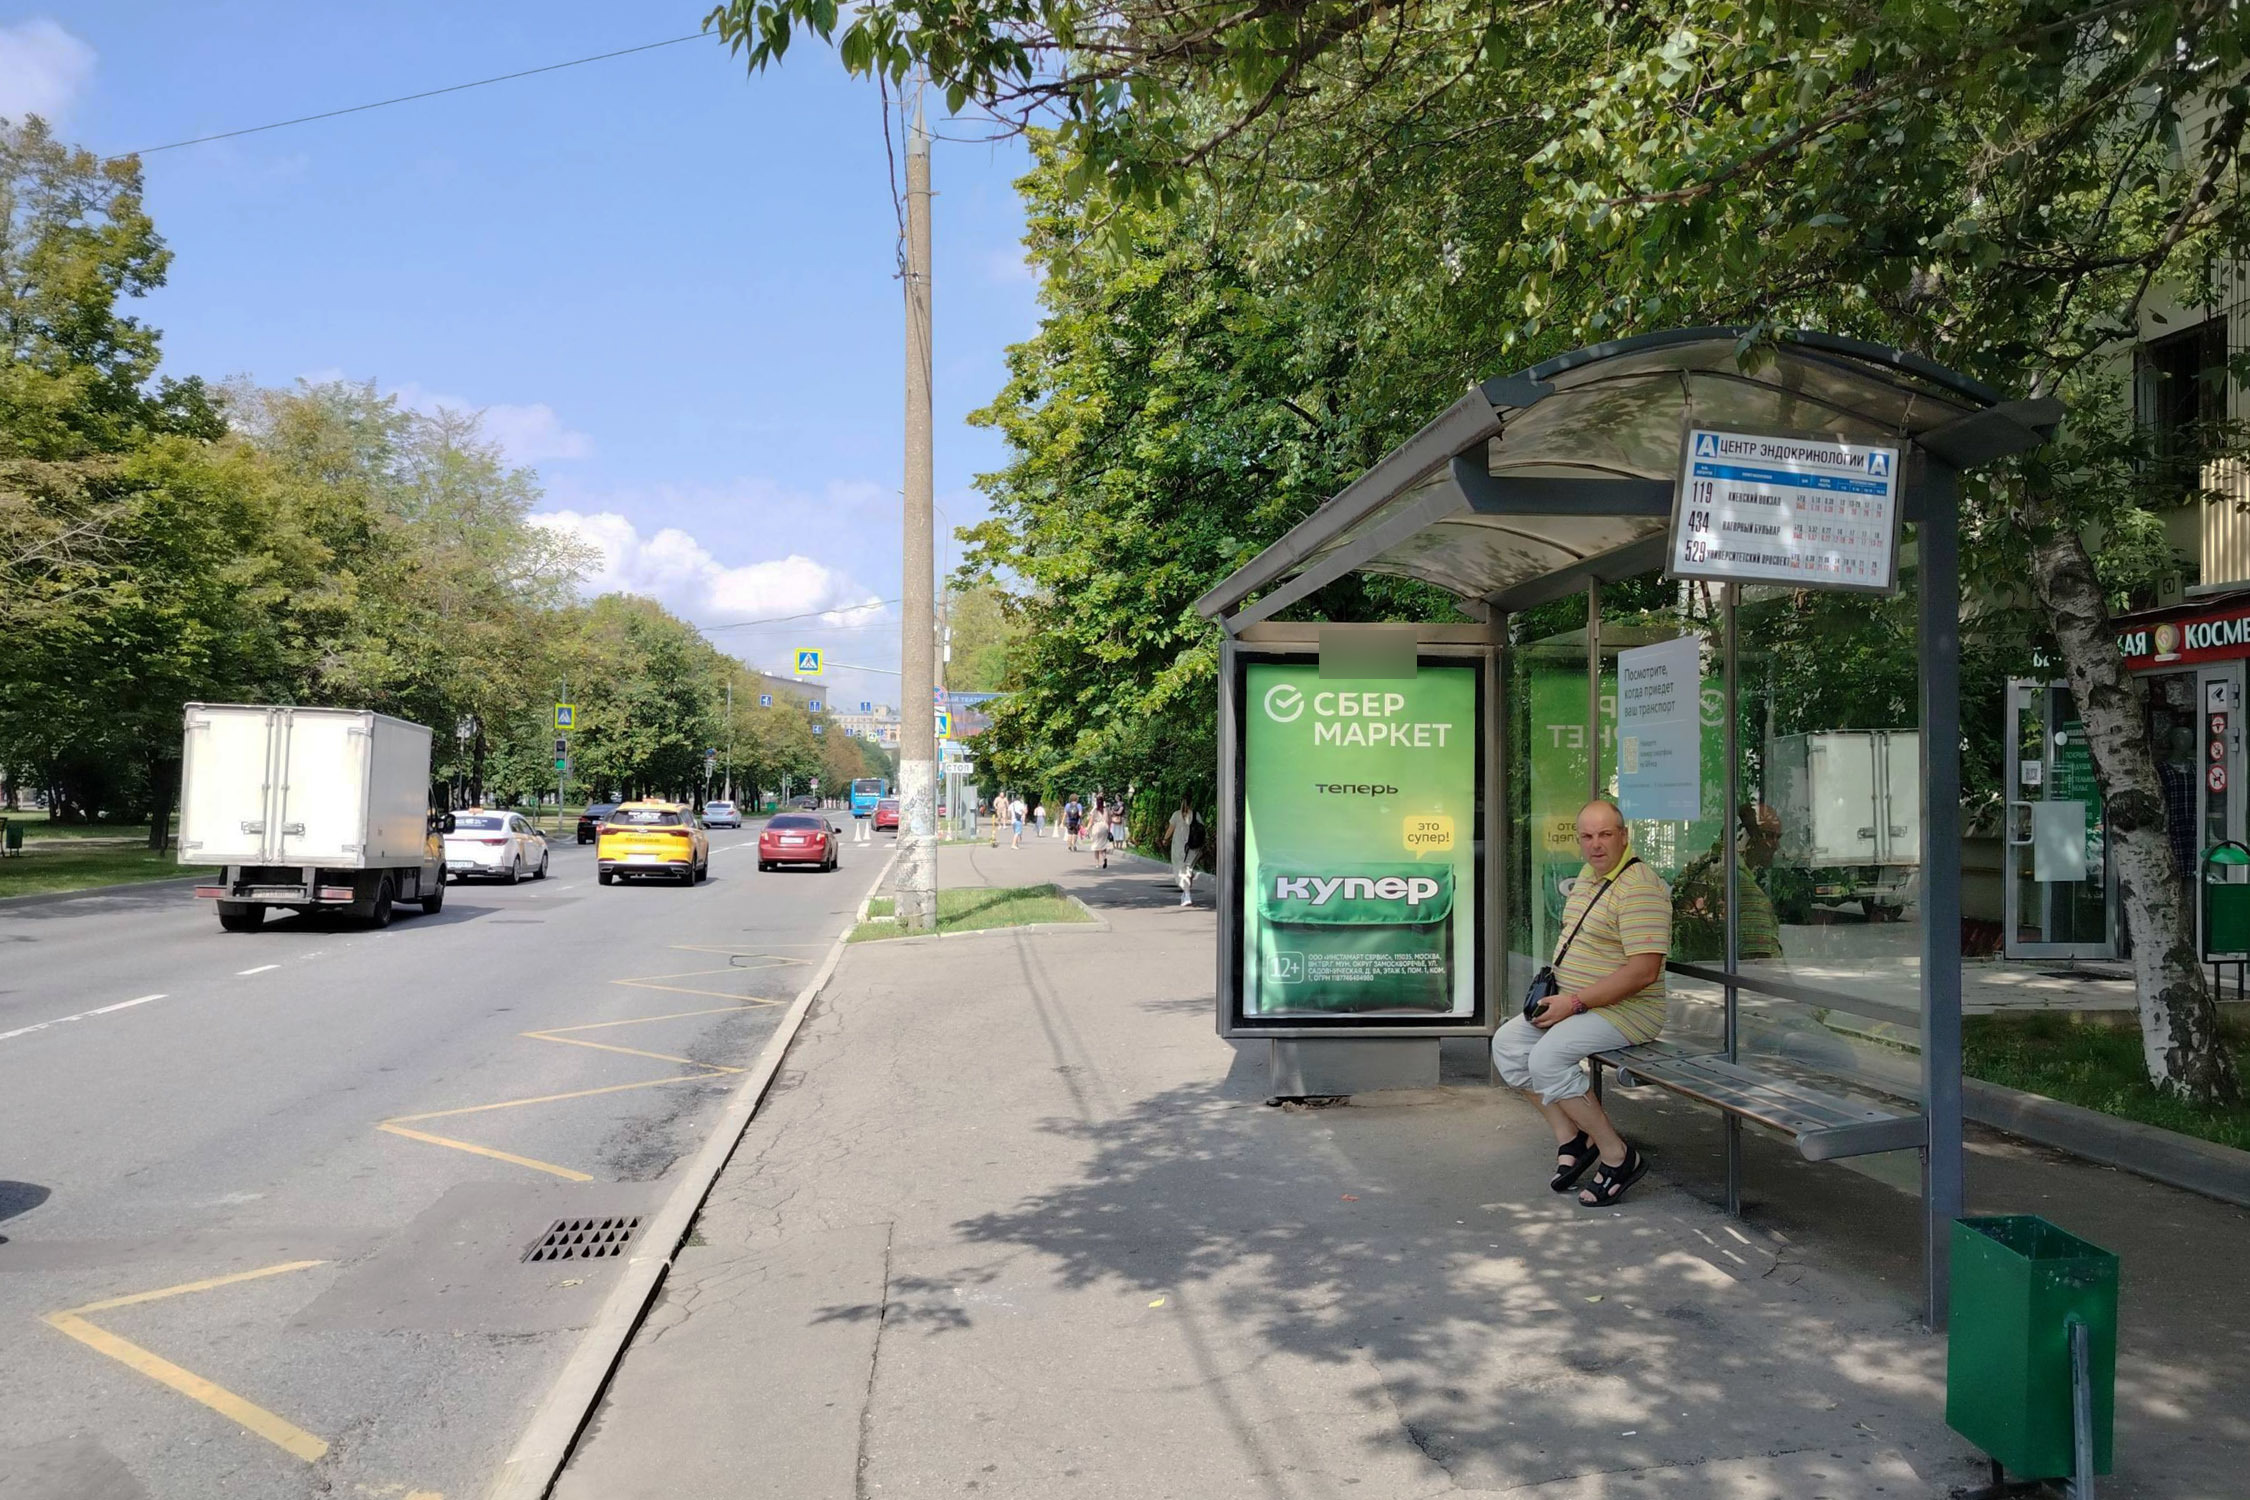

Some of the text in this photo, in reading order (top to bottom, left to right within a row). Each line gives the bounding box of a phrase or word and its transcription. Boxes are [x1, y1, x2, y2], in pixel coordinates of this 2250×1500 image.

[1719, 439, 1757, 456] ЦЕНТР
[1760, 444, 1865, 468] ЭНДОКРИНОЛОГИИ
[1692, 480, 1713, 504] 119
[1688, 510, 1710, 533] 434
[1685, 540, 1707, 563] 529
[1624, 665, 1668, 682] Посмотрите,
[1624, 682, 1674, 700] когда приедет
[1313, 692, 1405, 717] СБЕР
[1624, 706, 1638, 717] ваш
[1639, 701, 1676, 718] транспорт
[1314, 722, 1452, 748] МАРКЕТ
[946, 764, 970, 772] СТОП
[1315, 783, 1399, 797] теперь
[1417, 822, 1440, 832] это
[1407, 832, 1450, 845] супер!
[1275, 876, 1440, 906] купер
[1308, 953, 1323, 961] ООО
[1271, 957, 1300, 978] 12+
